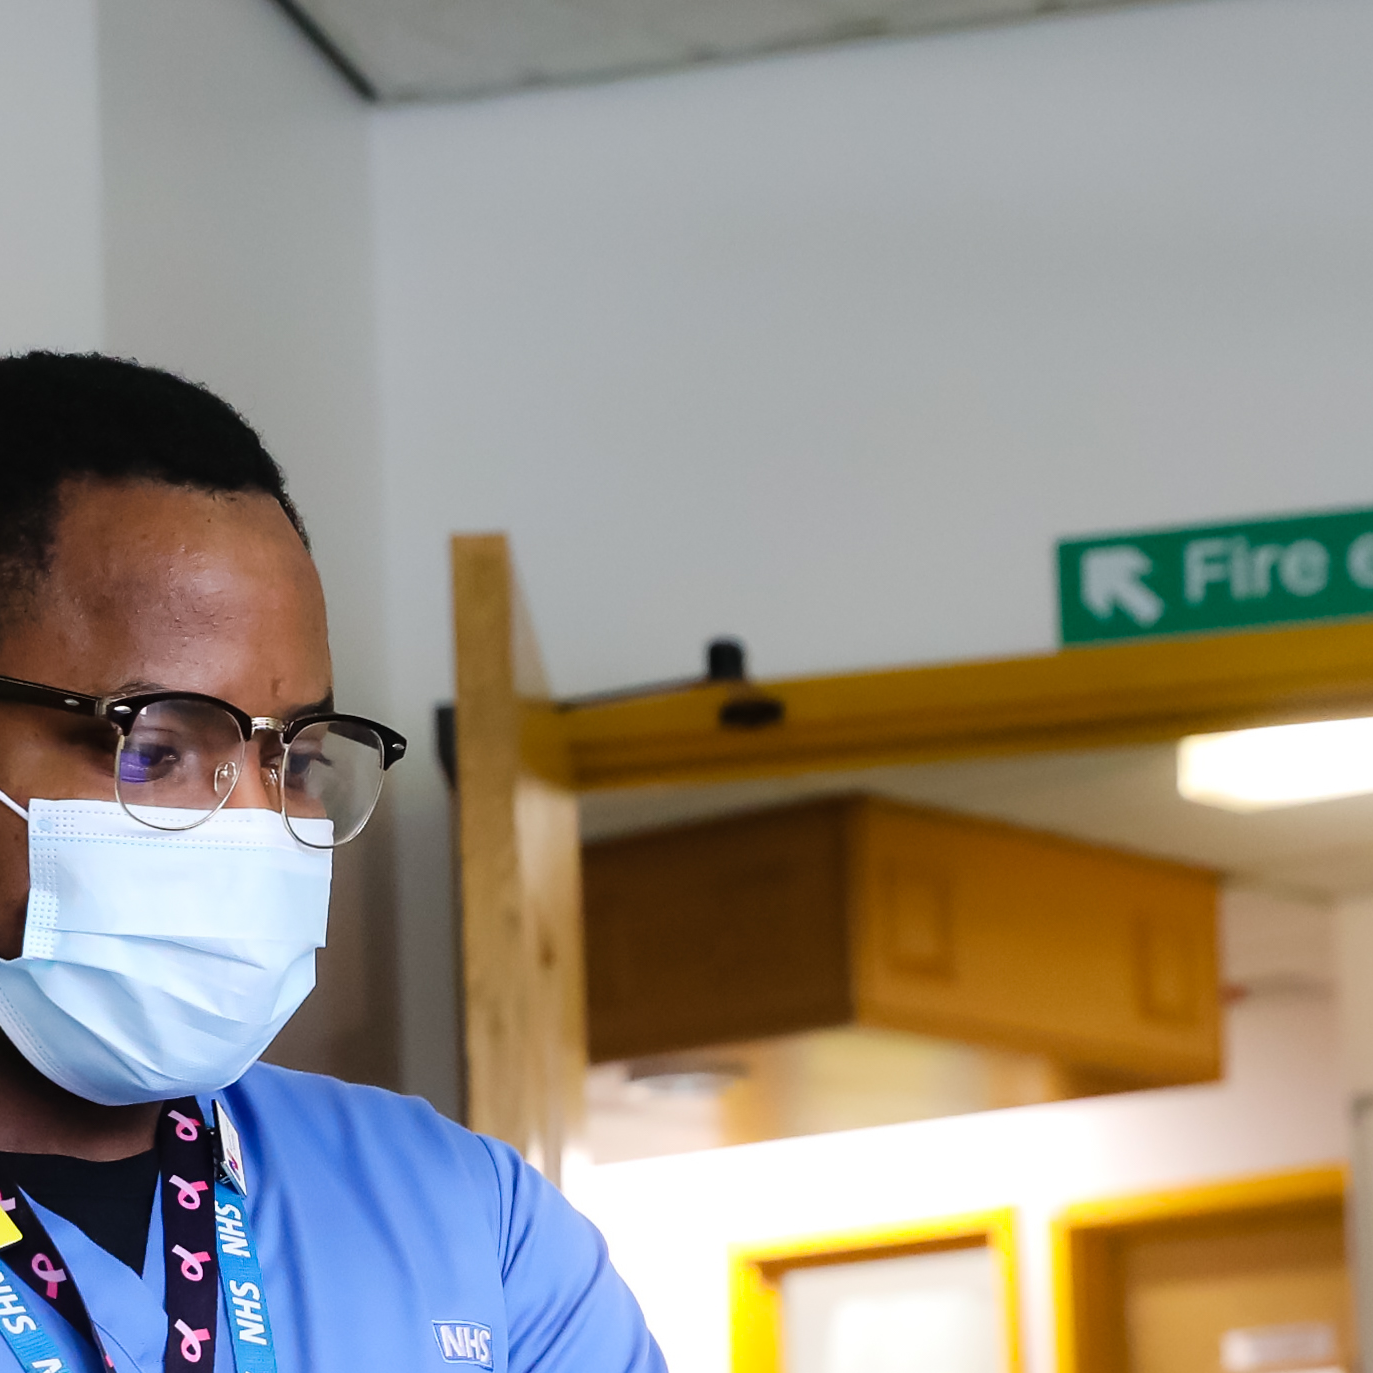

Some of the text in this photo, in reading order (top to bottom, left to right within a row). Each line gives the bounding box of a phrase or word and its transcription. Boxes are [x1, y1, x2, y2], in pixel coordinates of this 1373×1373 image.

[1184, 535, 1330, 607] Fire
[214, 1200, 251, 1258] NHS
[229, 1278, 268, 1346] NHS
[439, 1324, 492, 1364] NHS
